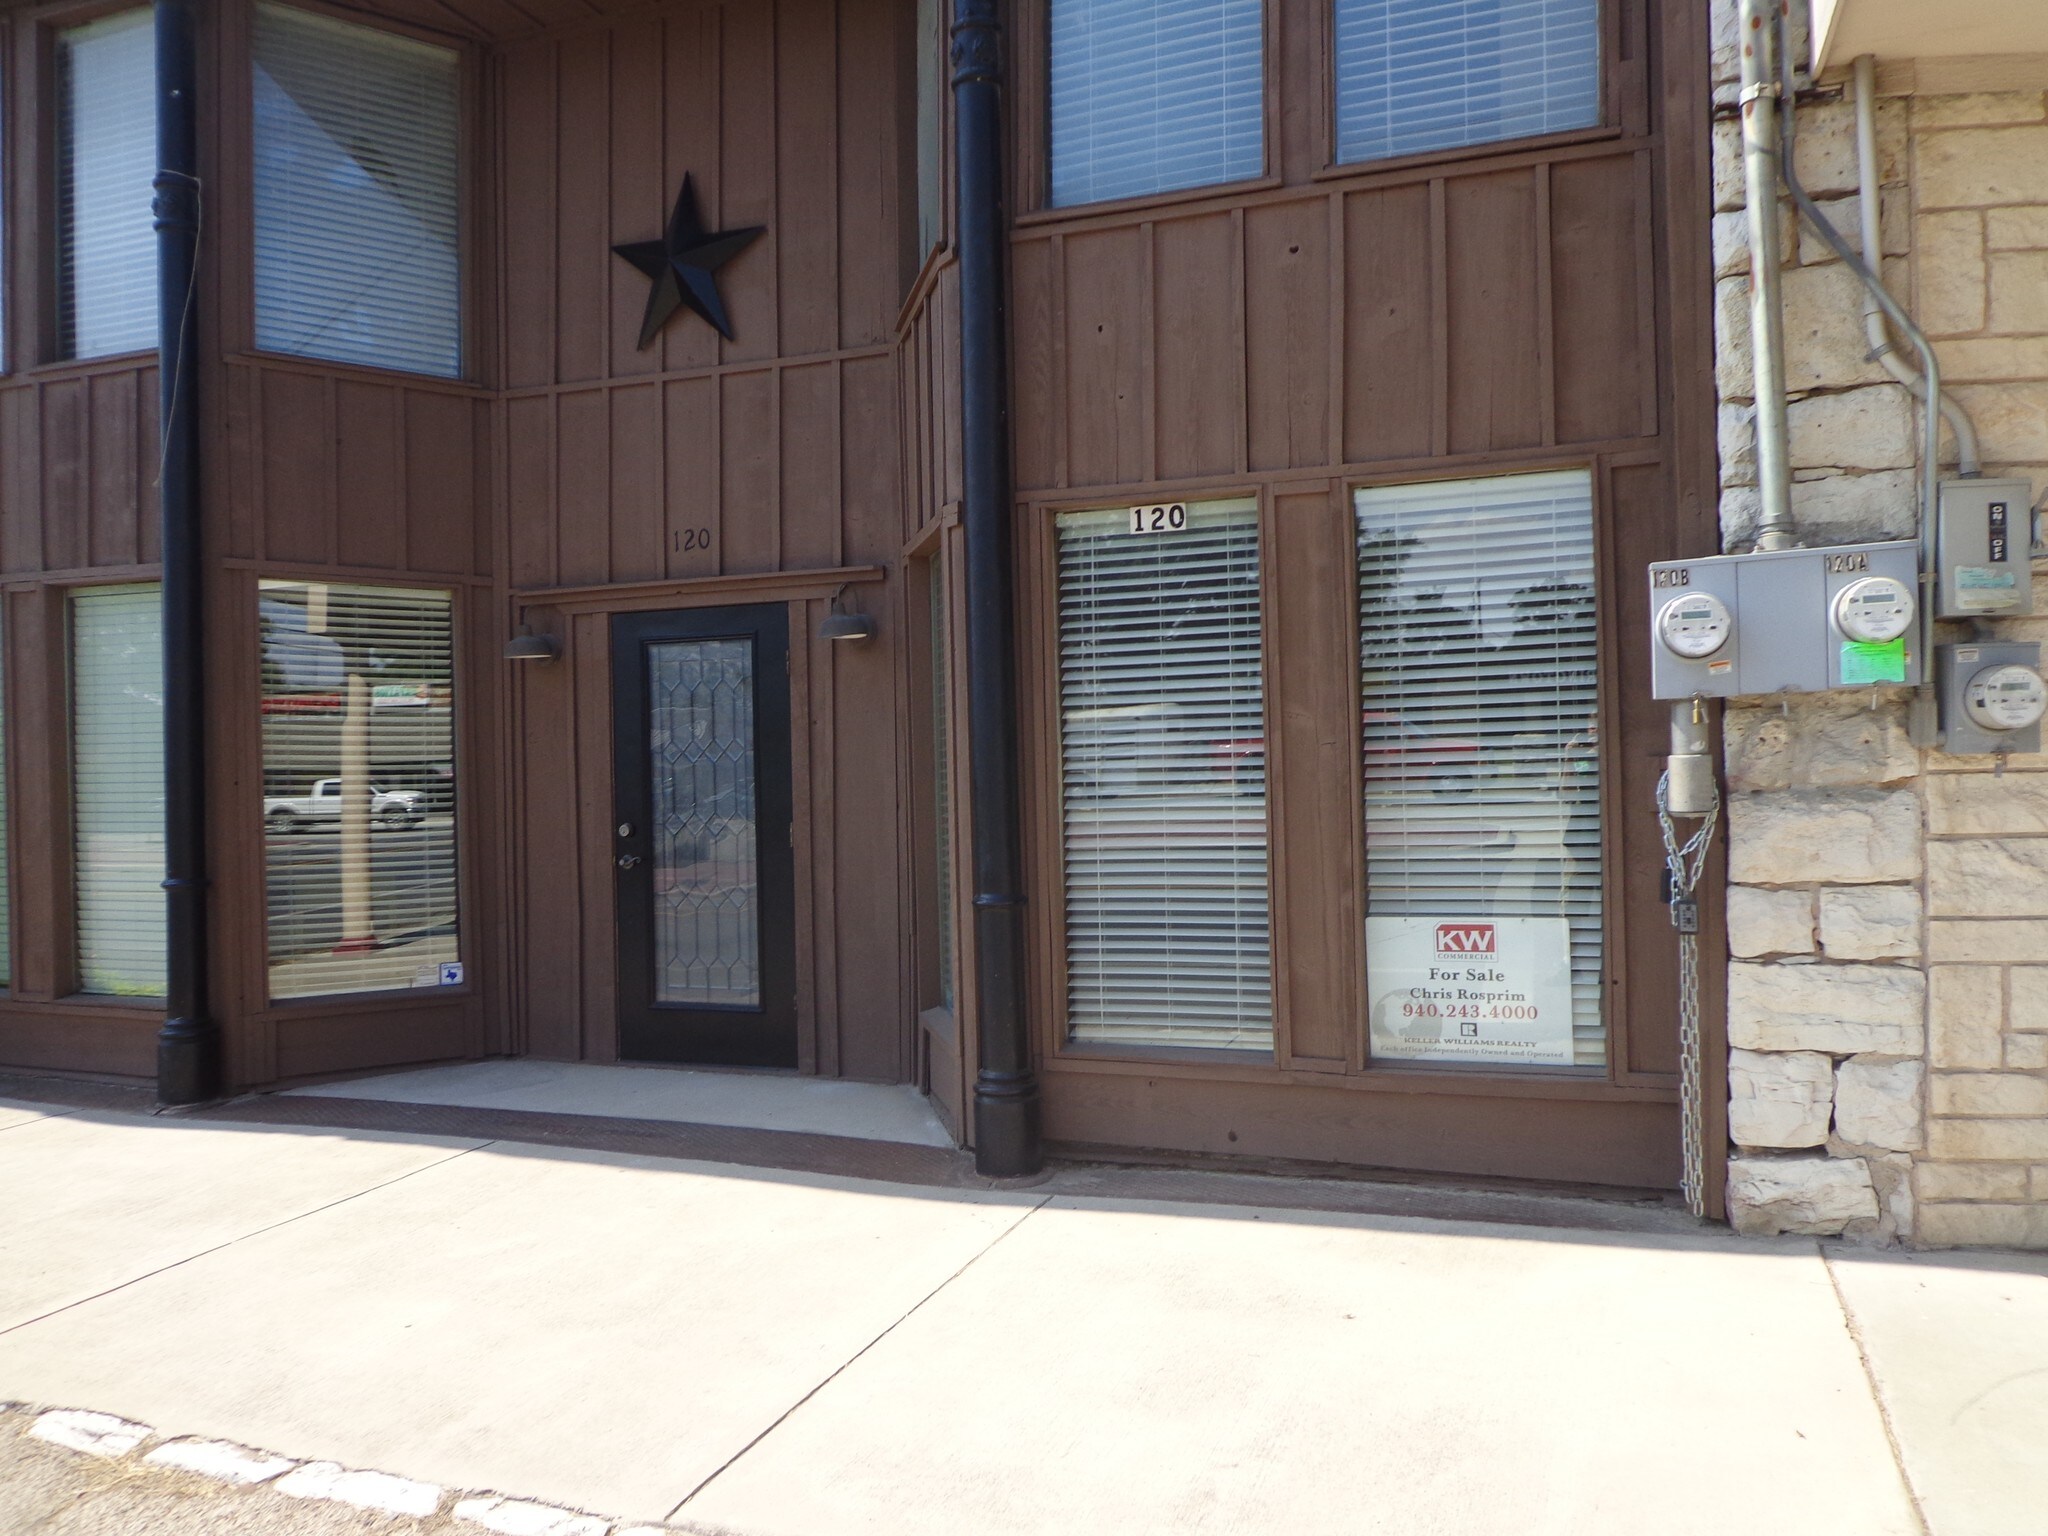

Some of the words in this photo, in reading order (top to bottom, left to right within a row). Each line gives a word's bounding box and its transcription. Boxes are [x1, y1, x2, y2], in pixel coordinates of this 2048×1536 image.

[1134, 504, 1185, 532] 120
[674, 528, 710, 552] 120
[1437, 930, 1493, 951] KW
[1429, 967, 1460, 981] For
[1466, 968, 1505, 982] Sale
[1410, 987, 1453, 1000] Chris
[1457, 988, 1526, 1004] Rosprim
[1402, 1003, 1539, 1020] 940.243.4000
[1444, 1038, 1495, 1046] WILLIAMS
[1496, 1040, 1538, 1048] REALTY
[1510, 1049, 1525, 1057] and
[1527, 1050, 1564, 1059] Operated
